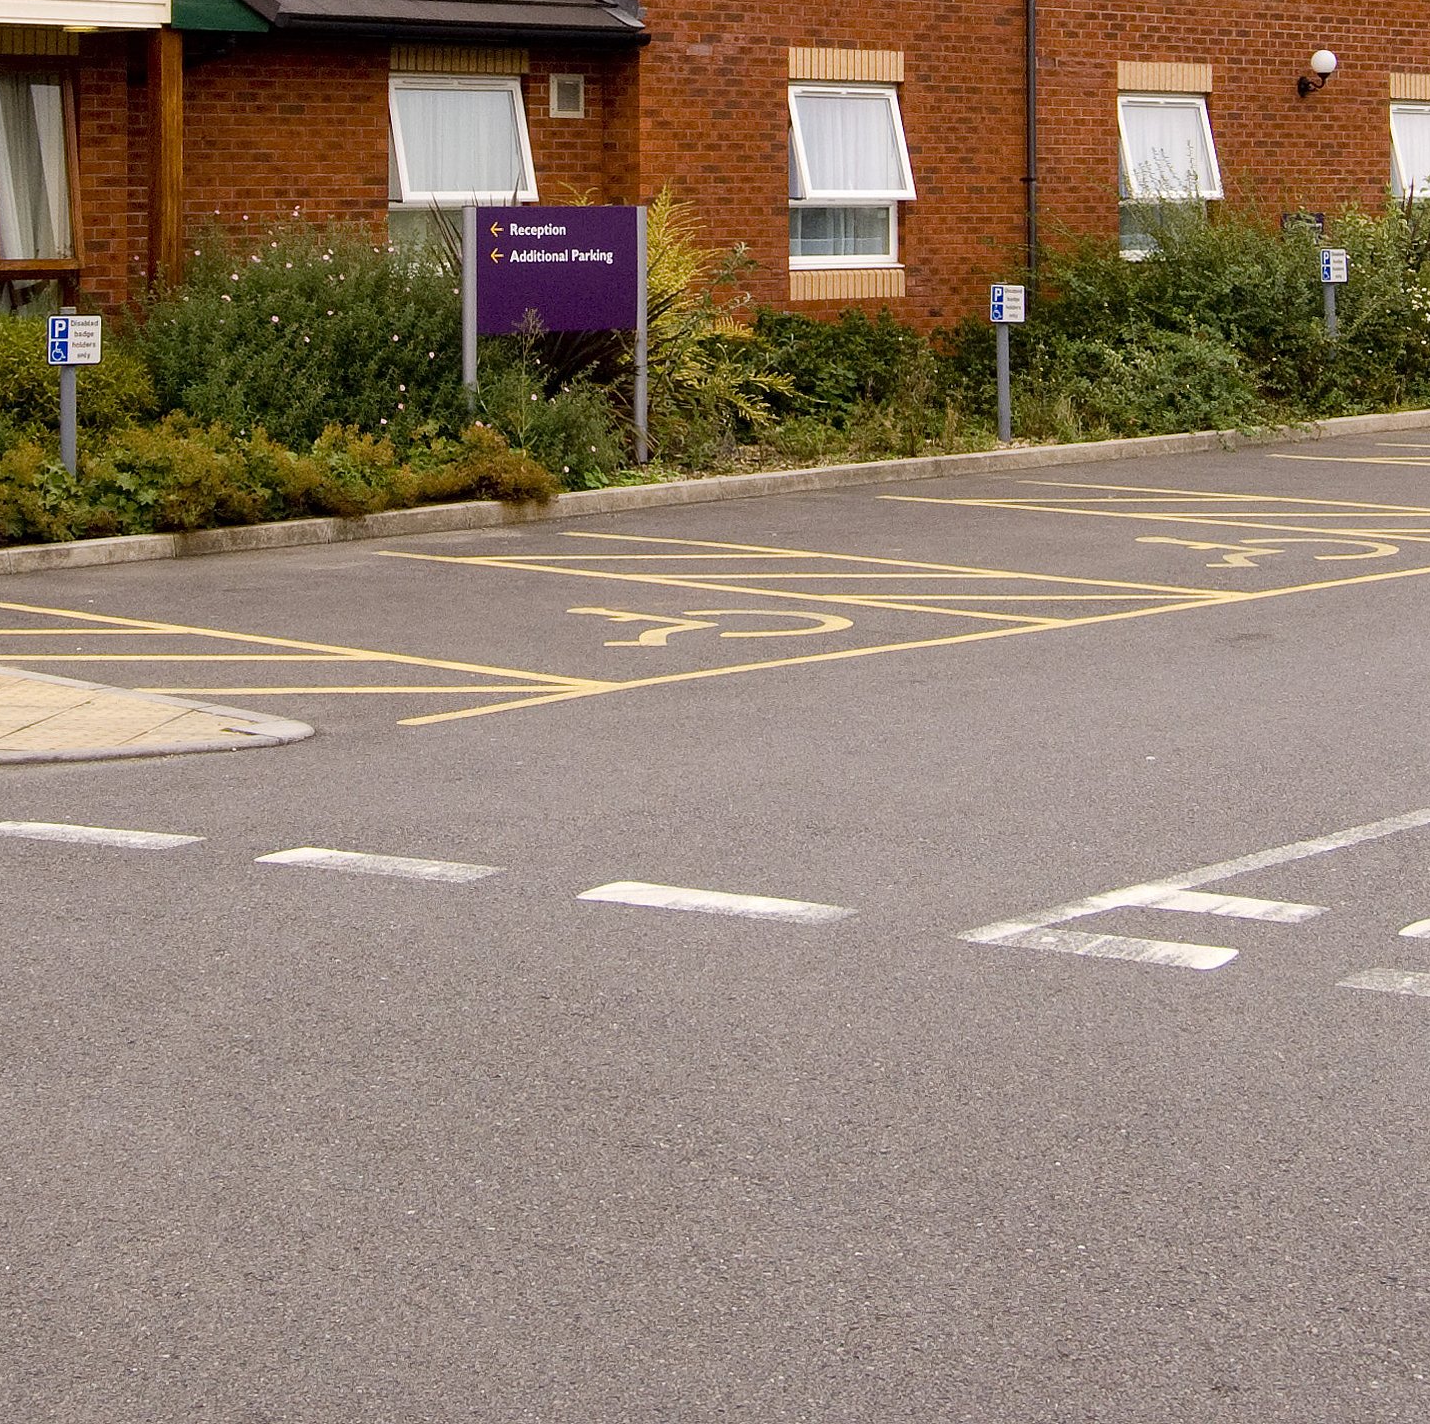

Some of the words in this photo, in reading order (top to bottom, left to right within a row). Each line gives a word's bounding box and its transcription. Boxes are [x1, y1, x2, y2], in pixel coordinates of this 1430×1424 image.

[509, 222, 567, 239] Reception
[509, 249, 569, 263] Additional
[571, 249, 614, 265] Parking
[55, 319, 67, 338] P
